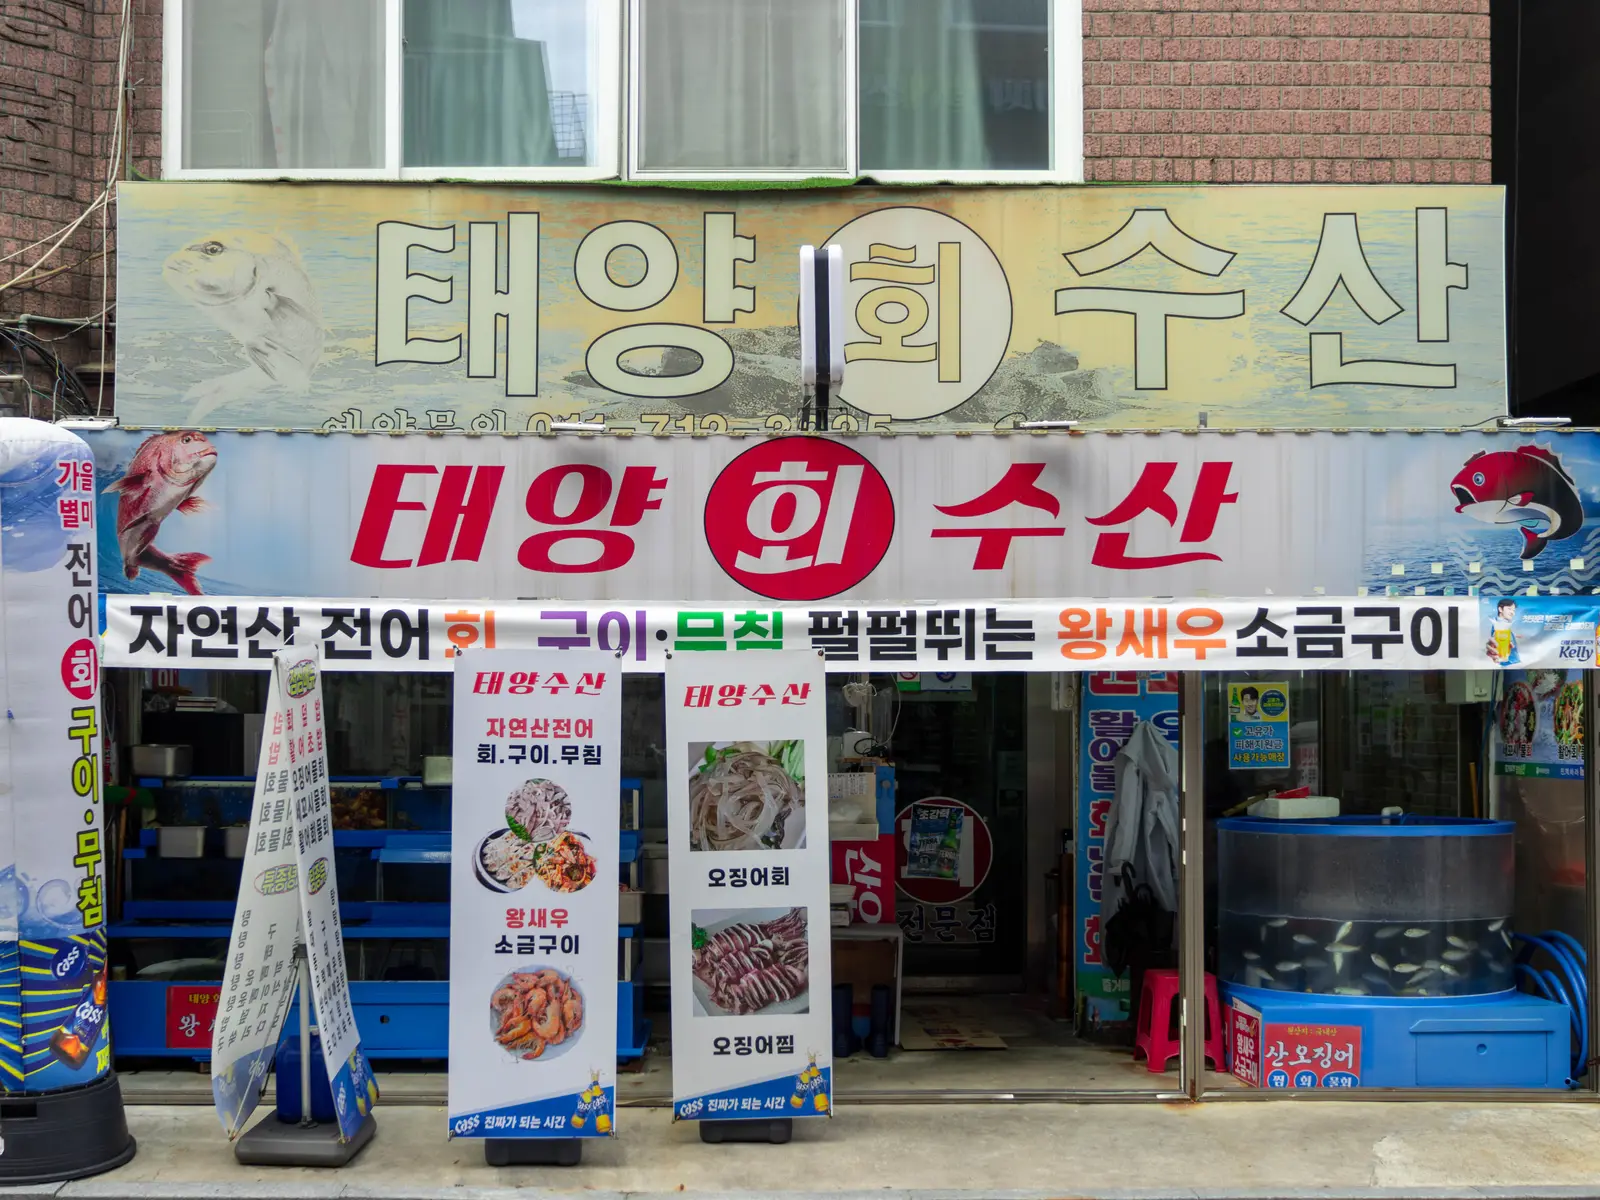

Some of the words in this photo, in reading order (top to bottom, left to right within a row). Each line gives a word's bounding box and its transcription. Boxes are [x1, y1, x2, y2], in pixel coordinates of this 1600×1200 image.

[375, 211, 756, 399] 태양
[844, 241, 962, 384] 회
[1054, 207, 1469, 390] 수산
[58, 462, 92, 492] 가을
[60, 499, 93, 529] 별미
[349, 464, 669, 574] 태양
[734, 461, 864, 574] 회
[930, 461, 1239, 570] 수산
[129, 604, 300, 660] 자연산
[808, 607, 1035, 661] 펄펄뛰는
[1057, 607, 1227, 660] 왕새우
[1236, 606, 1459, 660] 소금구이
[1559, 645, 1594, 661] Kelly
[472, 671, 607, 696] 태양수산
[683, 682, 812, 708] 태양수산
[486, 717, 594, 739] 자연산전어
[708, 866, 790, 888] 오징어회
[506, 908, 569, 929] 왕새우
[896, 904, 997, 943] 전문점
[494, 934, 580, 955] 소금구이
[713, 1034, 795, 1056] 오징어찜
[708, 1099, 739, 1112] 진짜가
[741, 1097, 762, 1110] 되는
[764, 1096, 786, 1110] 시간
[484, 1115, 517, 1129] 진짜가
[519, 1116, 541, 1129] 되는
[544, 1115, 566, 1129] 시간
